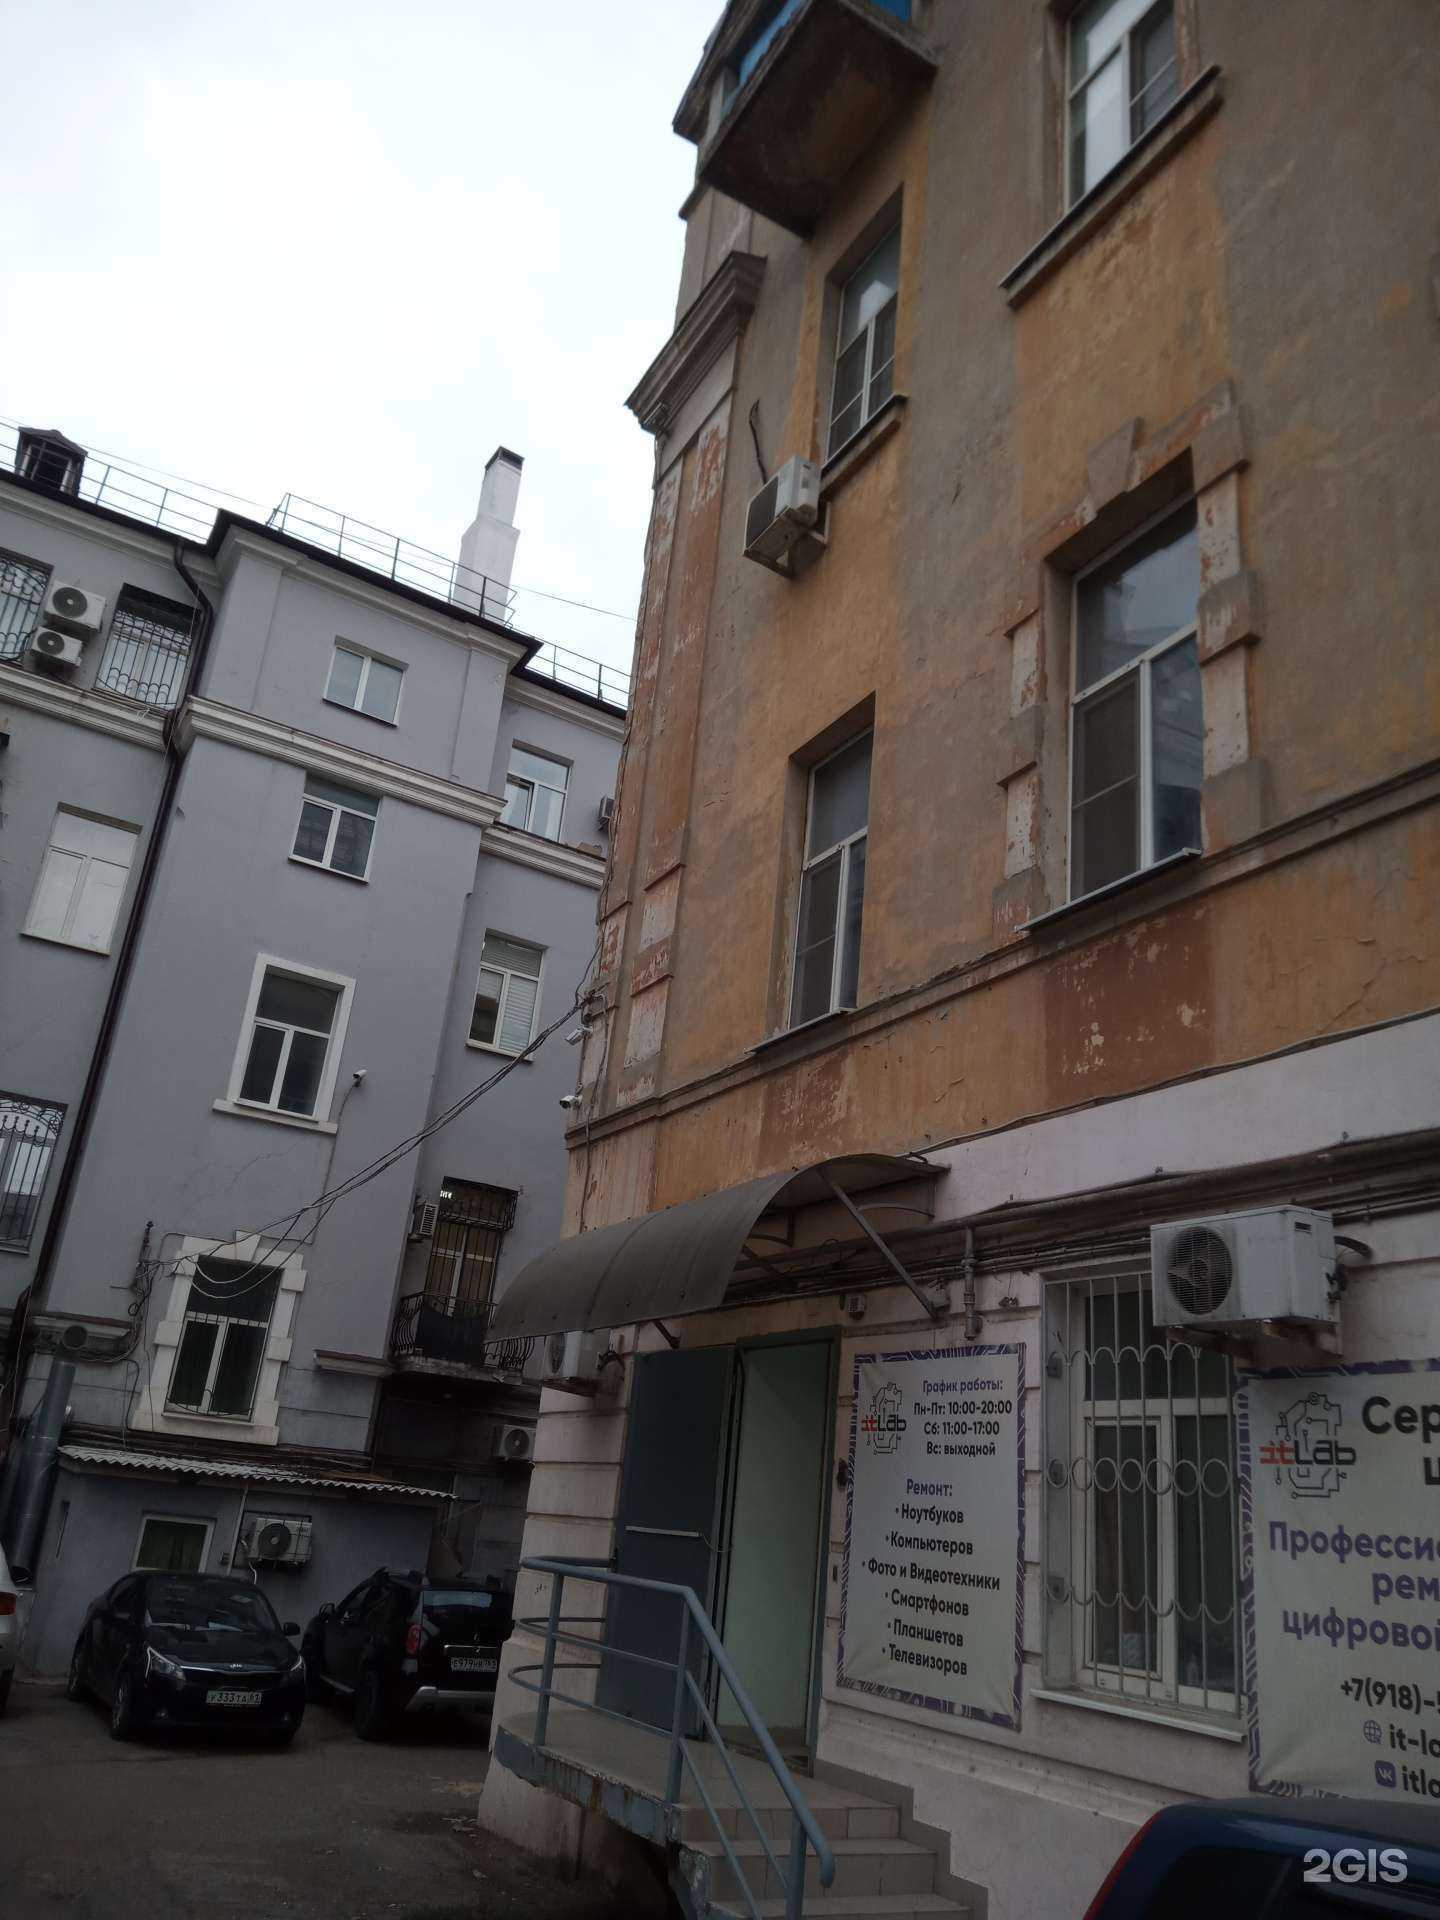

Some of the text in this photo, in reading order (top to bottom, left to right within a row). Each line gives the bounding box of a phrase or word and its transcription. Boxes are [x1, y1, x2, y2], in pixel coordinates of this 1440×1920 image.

[922, 1379, 1003, 1396] График работы:
[913, 1400, 1012, 1416] Пн-Пт: 10:00-20:00
[924, 1421, 1000, 1435] Сб: 11:00-17:00
[926, 1441, 996, 1458] Вс: выходной
[906, 1478, 953, 1497] Ремонт:
[901, 1503, 964, 1526] Ноутбуков
[890, 1531, 974, 1557] Компьютеров
[1269, 1521, 1440, 1564] Професси
[868, 1557, 1000, 1591] Фото и Видеотехники
[891, 1588, 969, 1617] Смартфонов
[893, 1618, 964, 1648] Планшетов
[888, 1643, 968, 1676] Телевизоров
[1340, 1677, 1440, 1715] +7(918)-
